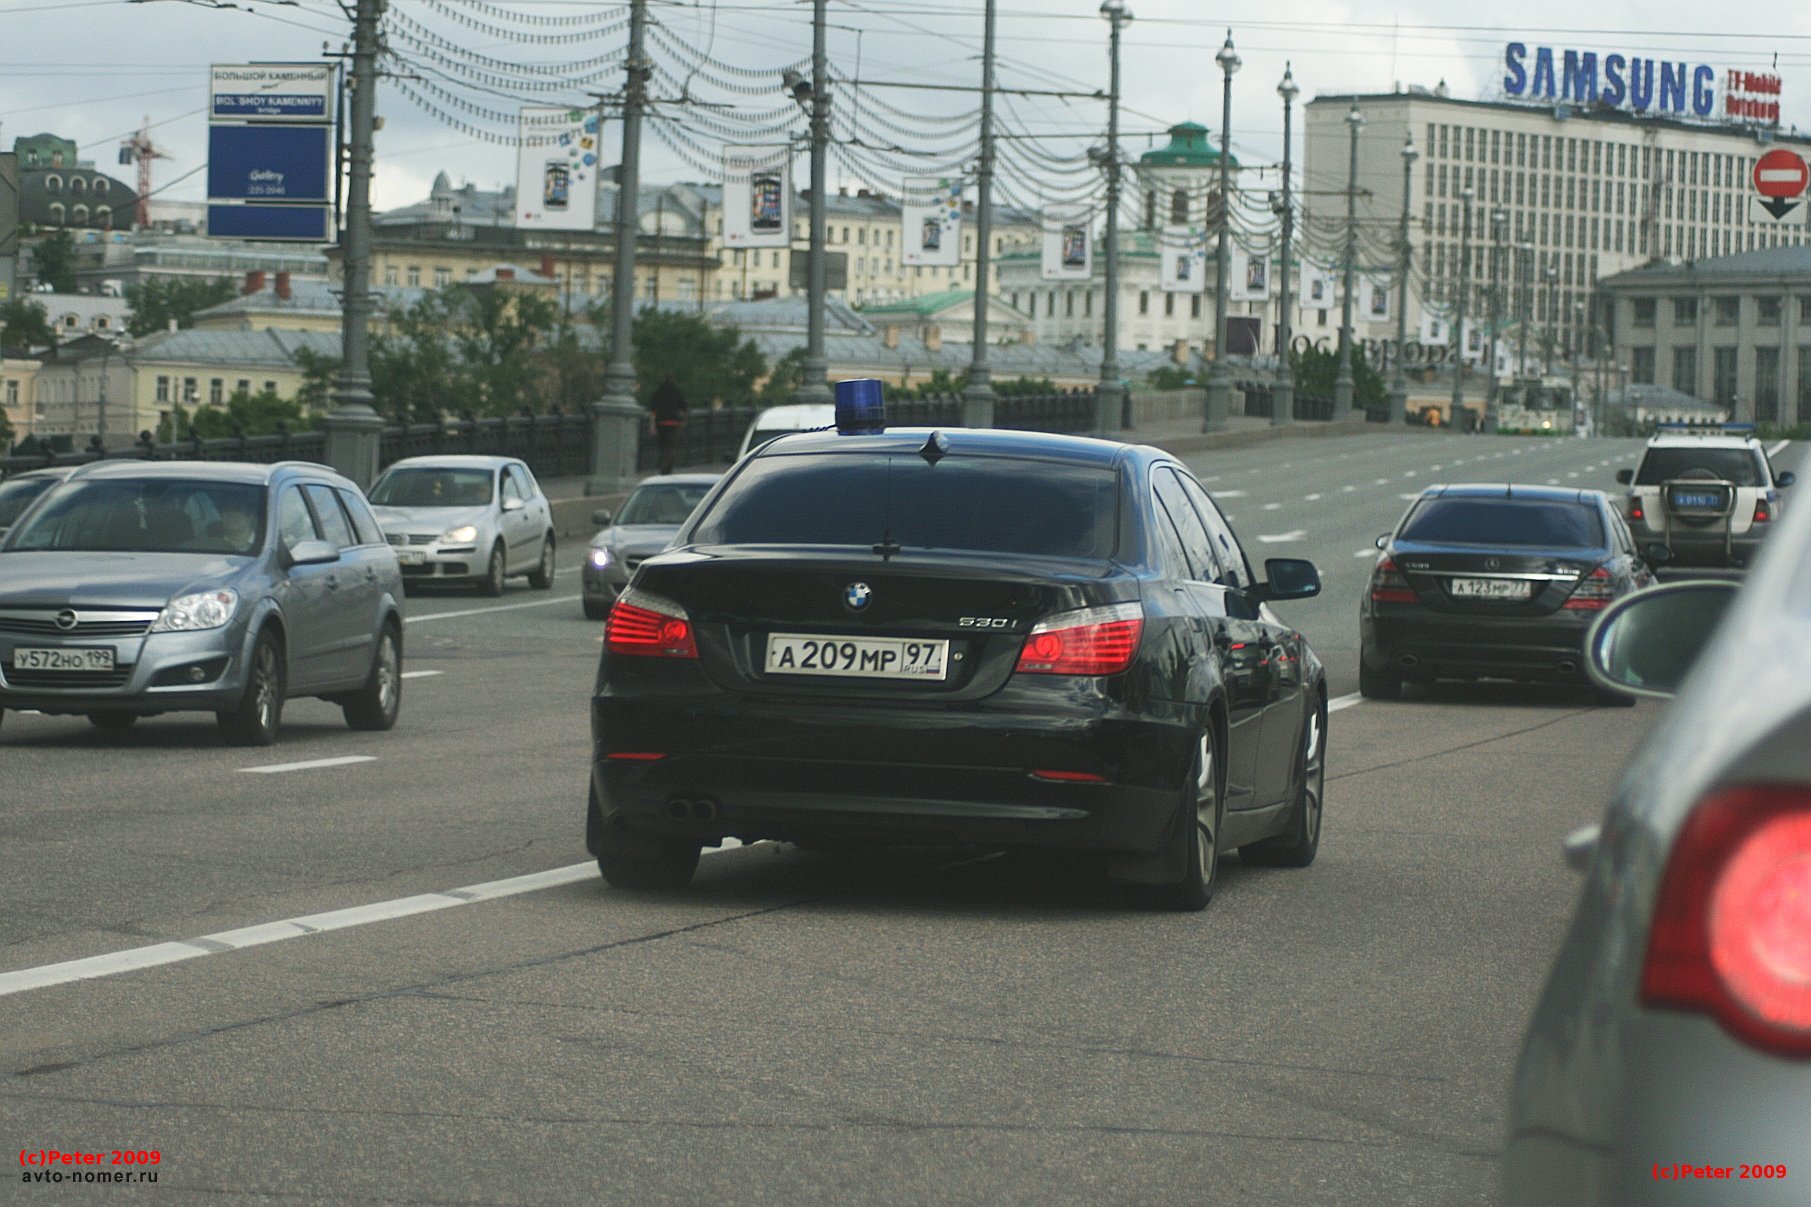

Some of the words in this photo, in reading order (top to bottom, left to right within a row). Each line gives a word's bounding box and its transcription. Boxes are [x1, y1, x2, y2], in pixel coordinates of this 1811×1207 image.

[214, 70, 266, 80] БОЛЬШОЙ
[1504, 42, 1714, 116] SAMSUNG
[86, 651, 111, 664] 199
[778, 641, 897, 671] А209МР
[907, 643, 937, 666] 97
[903, 665, 926, 675] RUS
